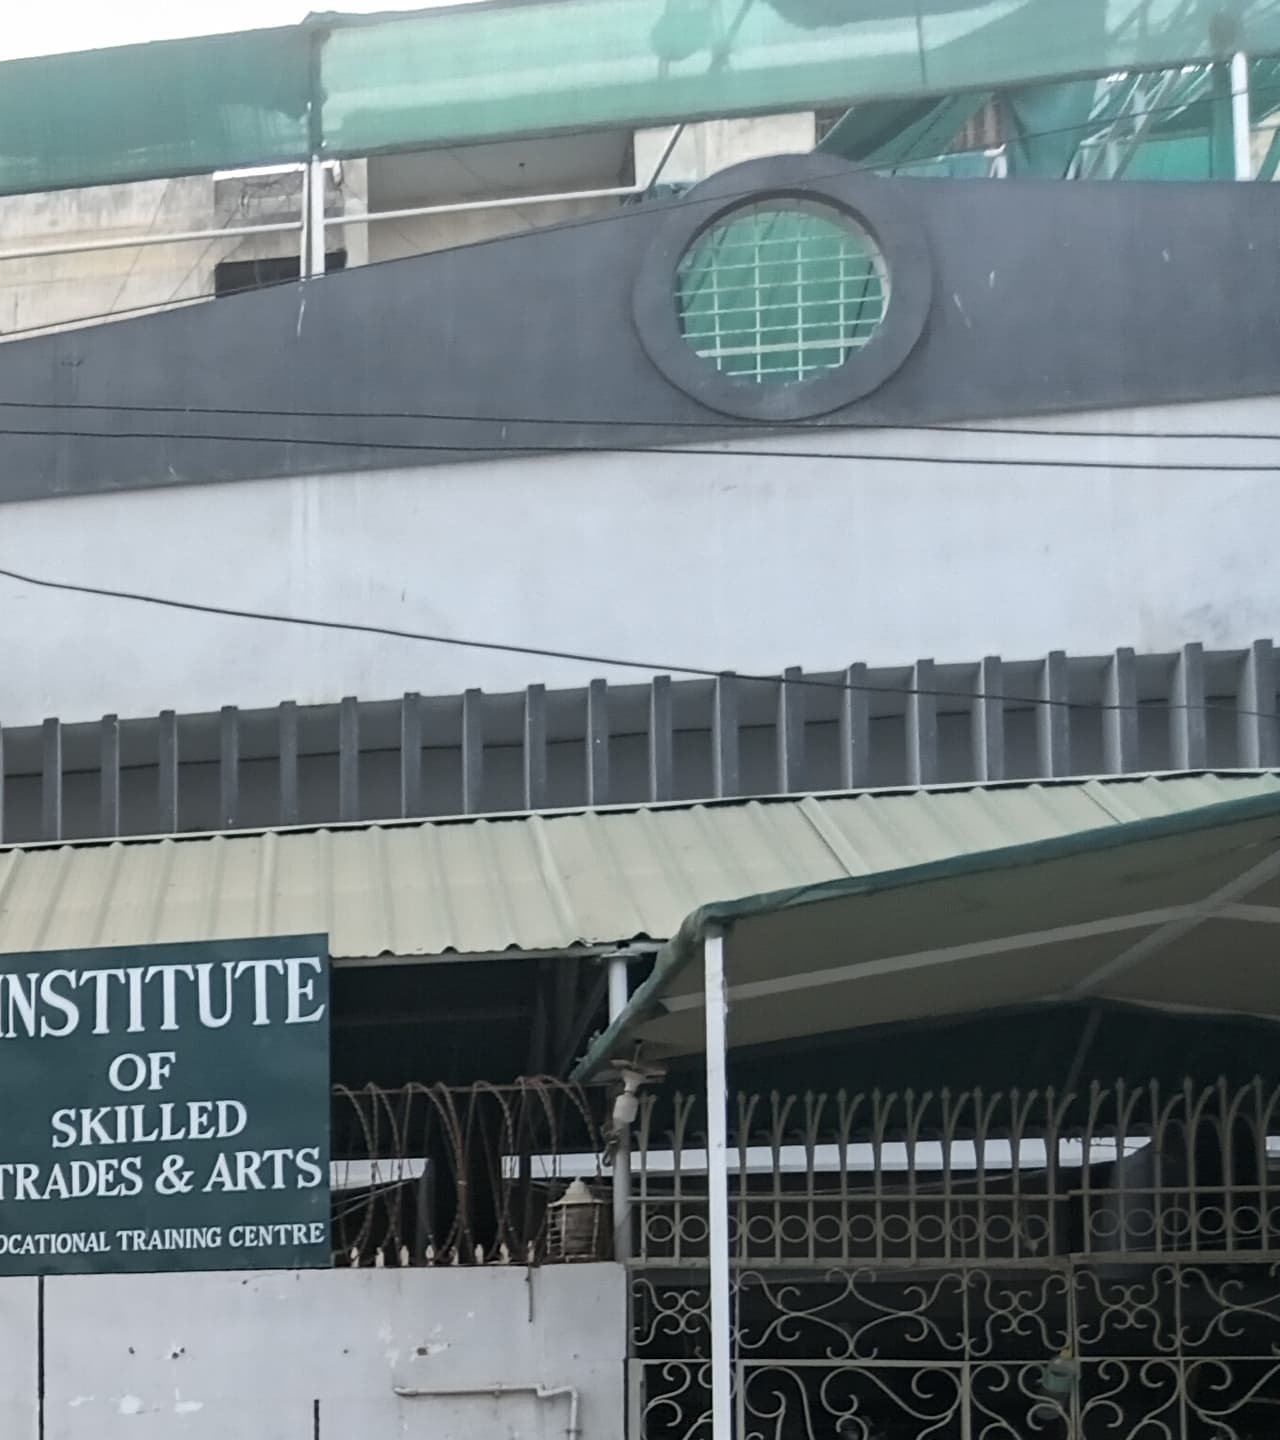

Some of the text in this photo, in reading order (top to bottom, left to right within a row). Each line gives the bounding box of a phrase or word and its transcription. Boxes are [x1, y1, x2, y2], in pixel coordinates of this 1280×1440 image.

[109, 1051, 176, 1092] OF
[51, 1099, 247, 1148] SKILLED
[155, 1154, 194, 1196] &
[202, 1146, 323, 1193] ARTS
[116, 1227, 222, 1252] TRAINING
[228, 1222, 325, 1248] CENTRE
